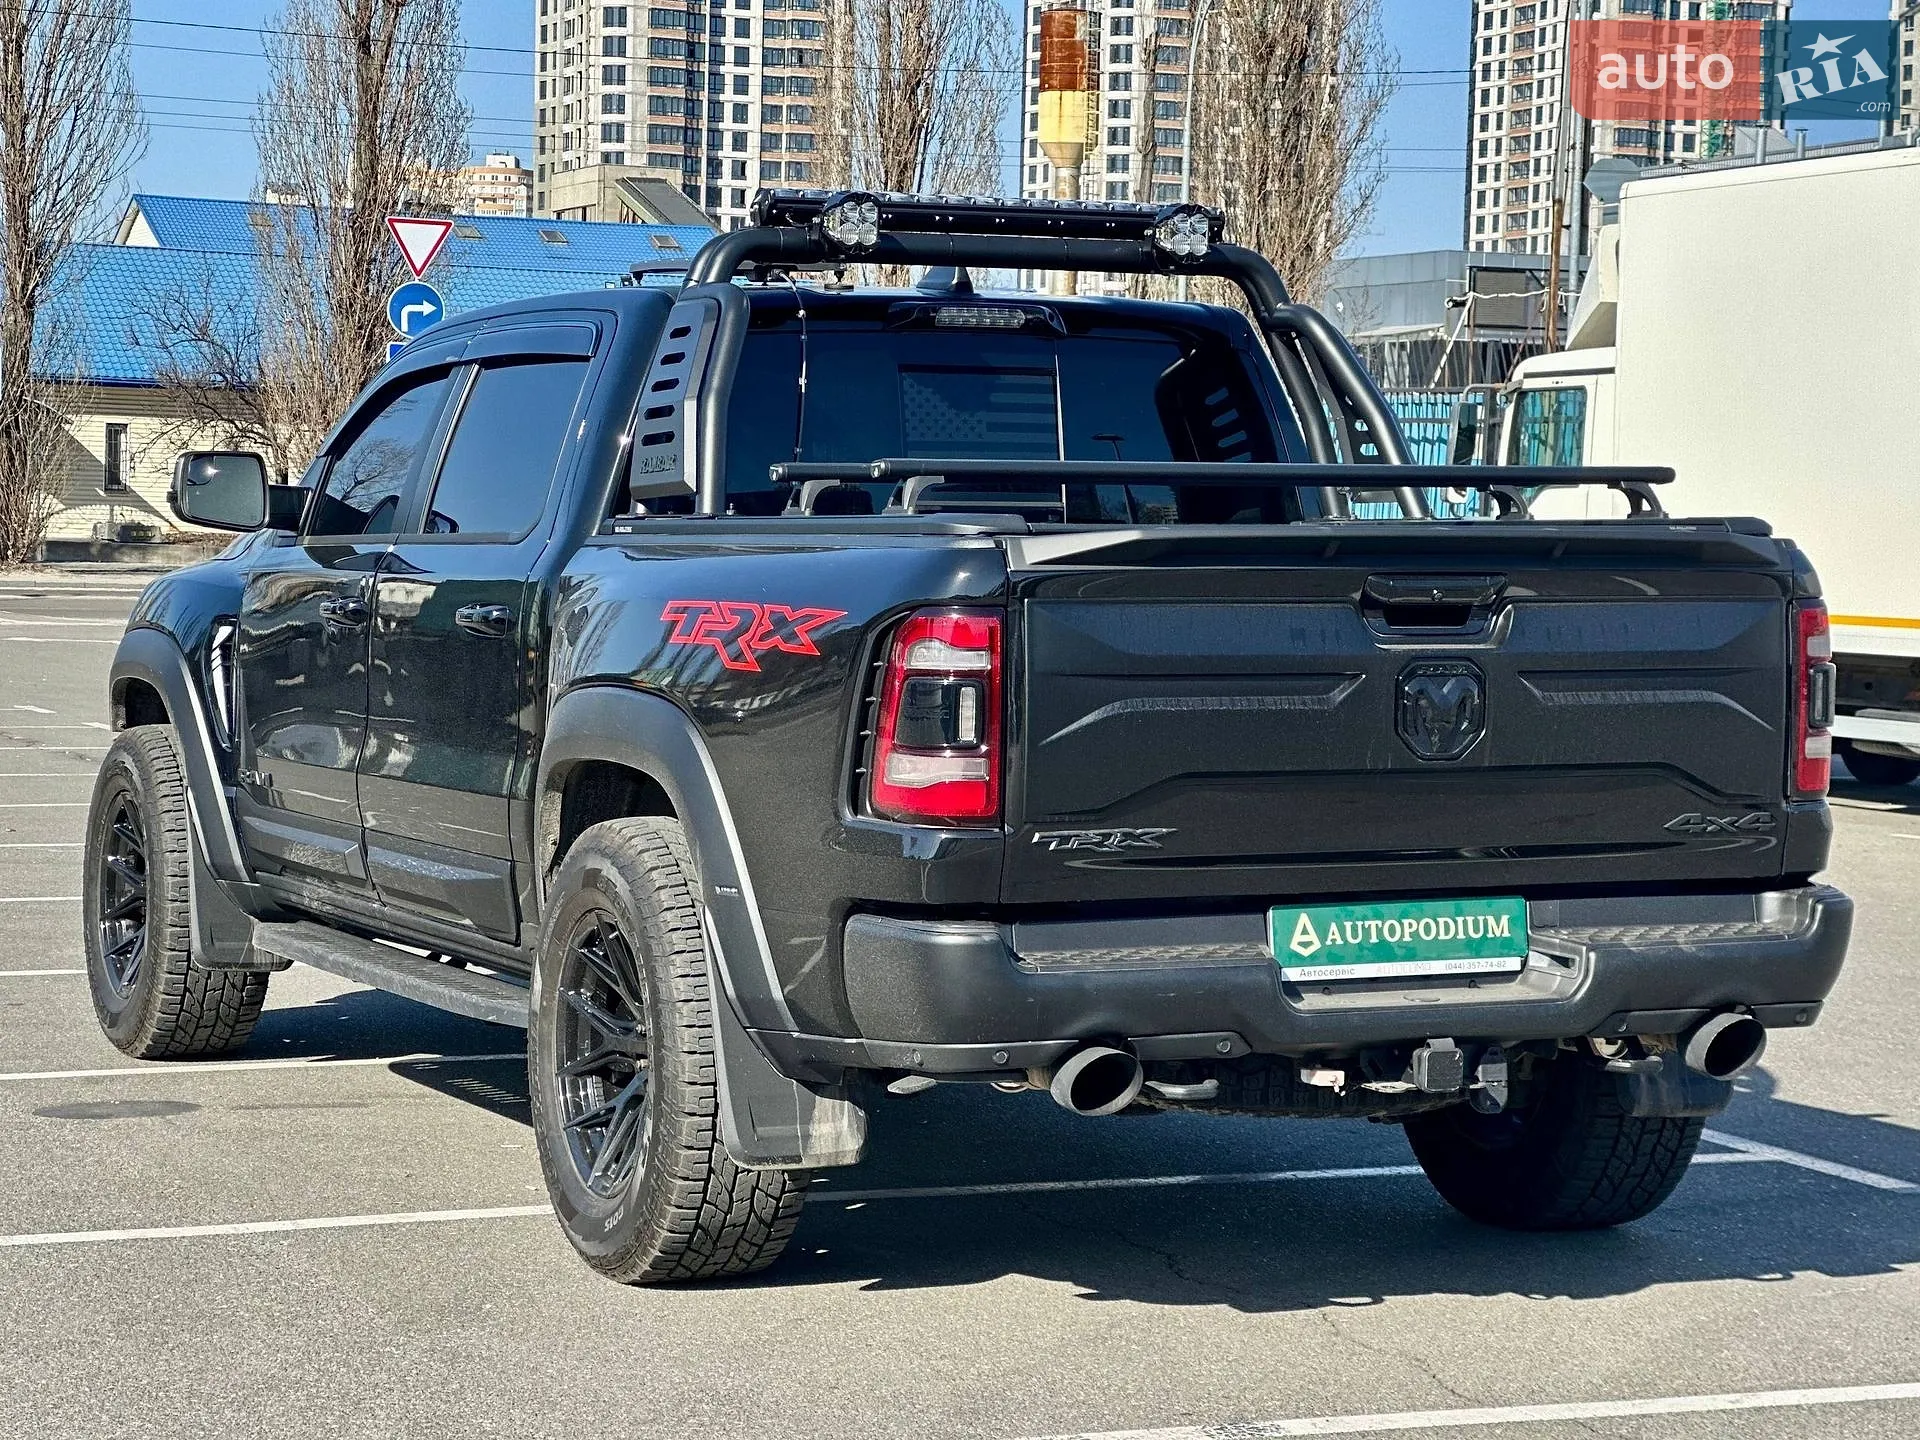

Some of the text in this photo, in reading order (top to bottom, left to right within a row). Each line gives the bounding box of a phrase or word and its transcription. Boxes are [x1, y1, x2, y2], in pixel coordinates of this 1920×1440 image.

[660, 600, 849, 672] TRX
[1031, 827, 1179, 852] TRX
[1325, 914, 1512, 946] AUTOPODIUM
